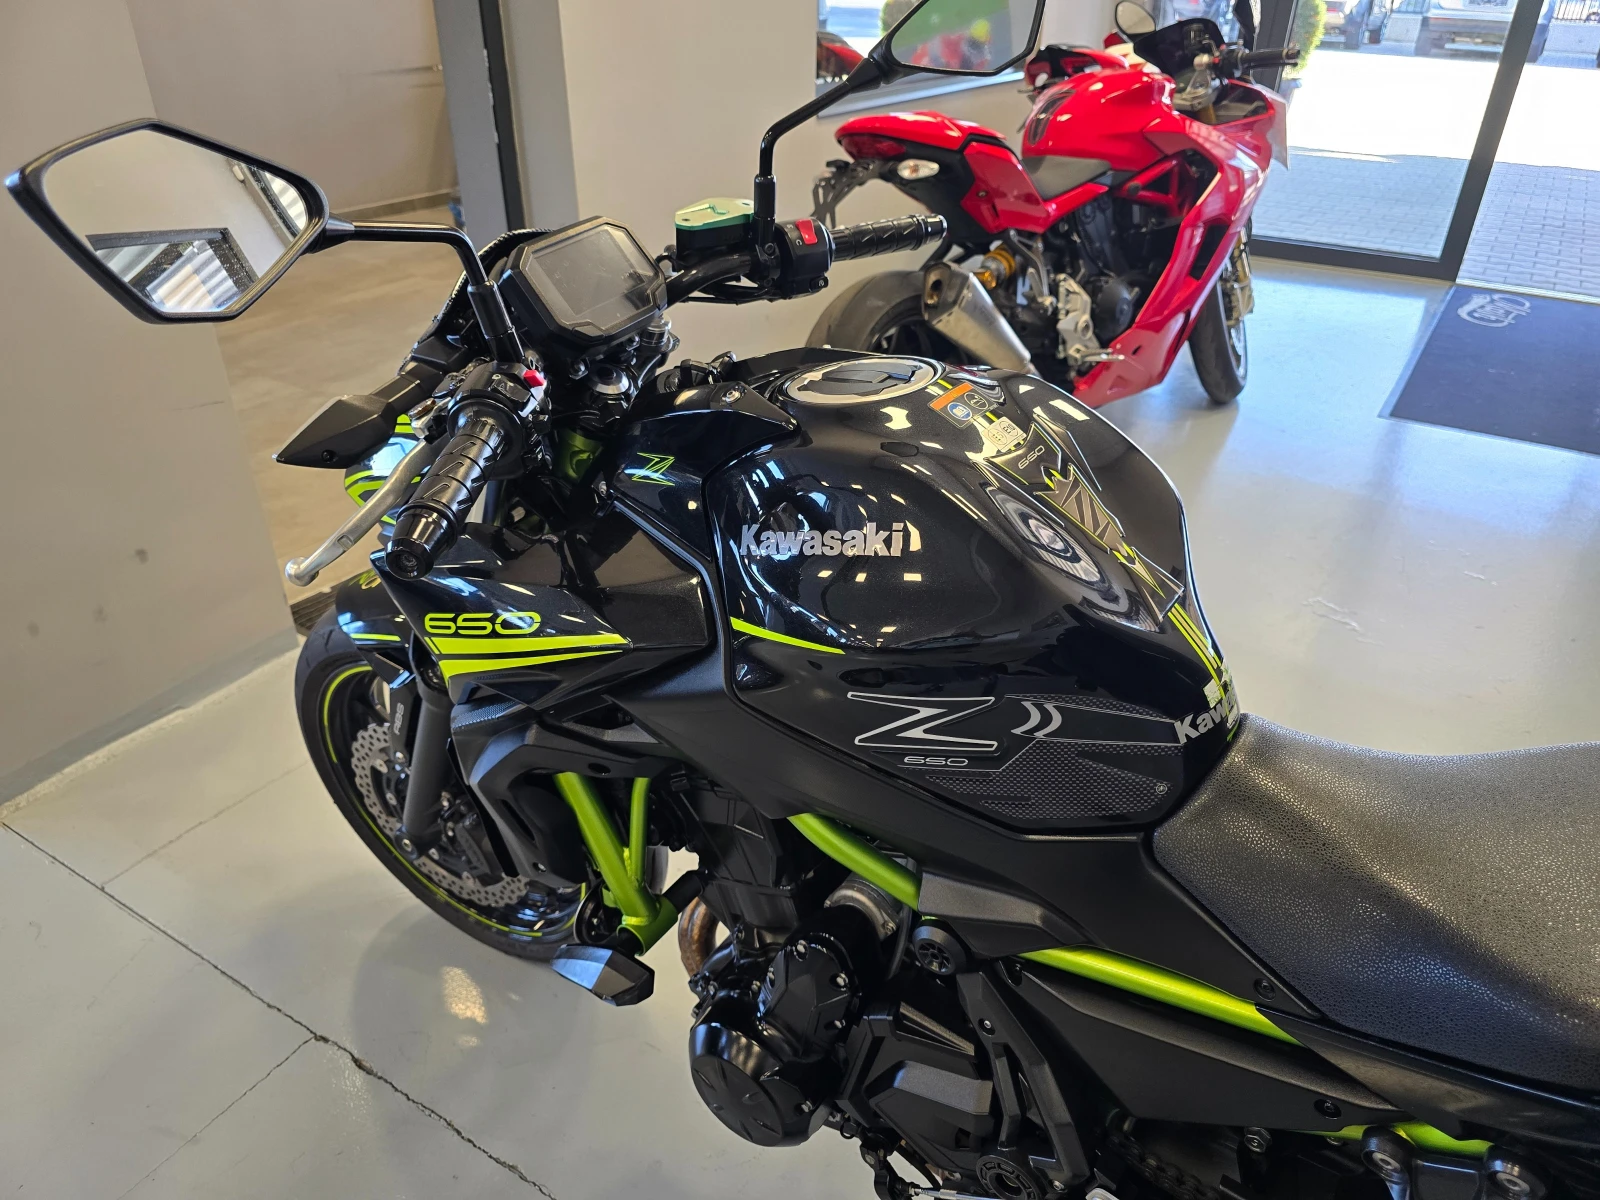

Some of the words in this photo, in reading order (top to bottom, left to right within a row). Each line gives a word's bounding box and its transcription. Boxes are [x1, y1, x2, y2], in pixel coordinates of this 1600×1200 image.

[1018, 445, 1045, 469] 650
[740, 522, 905, 557] Kawasaki
[424, 611, 541, 635] 650
[393, 703, 405, 735] ABS
[1174, 690, 1234, 745] Kawa
[903, 756, 969, 766] 650
